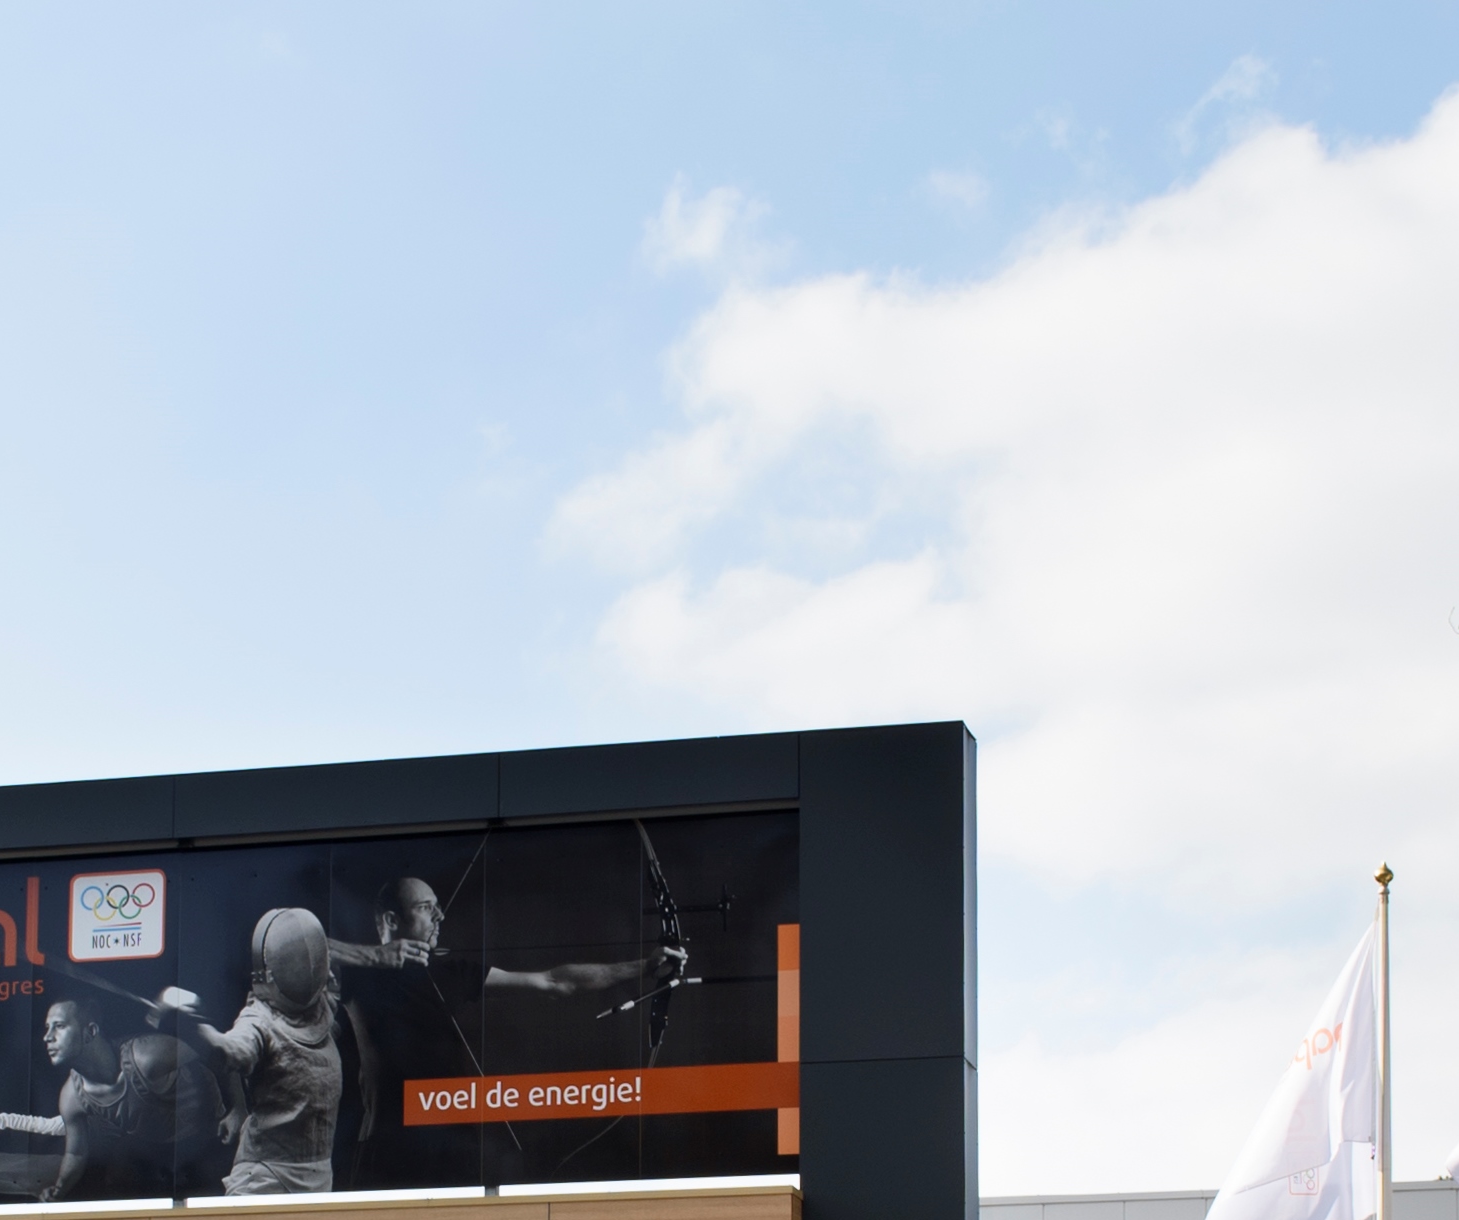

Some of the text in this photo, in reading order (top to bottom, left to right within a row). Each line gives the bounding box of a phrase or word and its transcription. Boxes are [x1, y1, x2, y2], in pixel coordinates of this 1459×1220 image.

[92, 932, 142, 949] NOC NSF
[418, 1076, 642, 1111] voel de energie!
